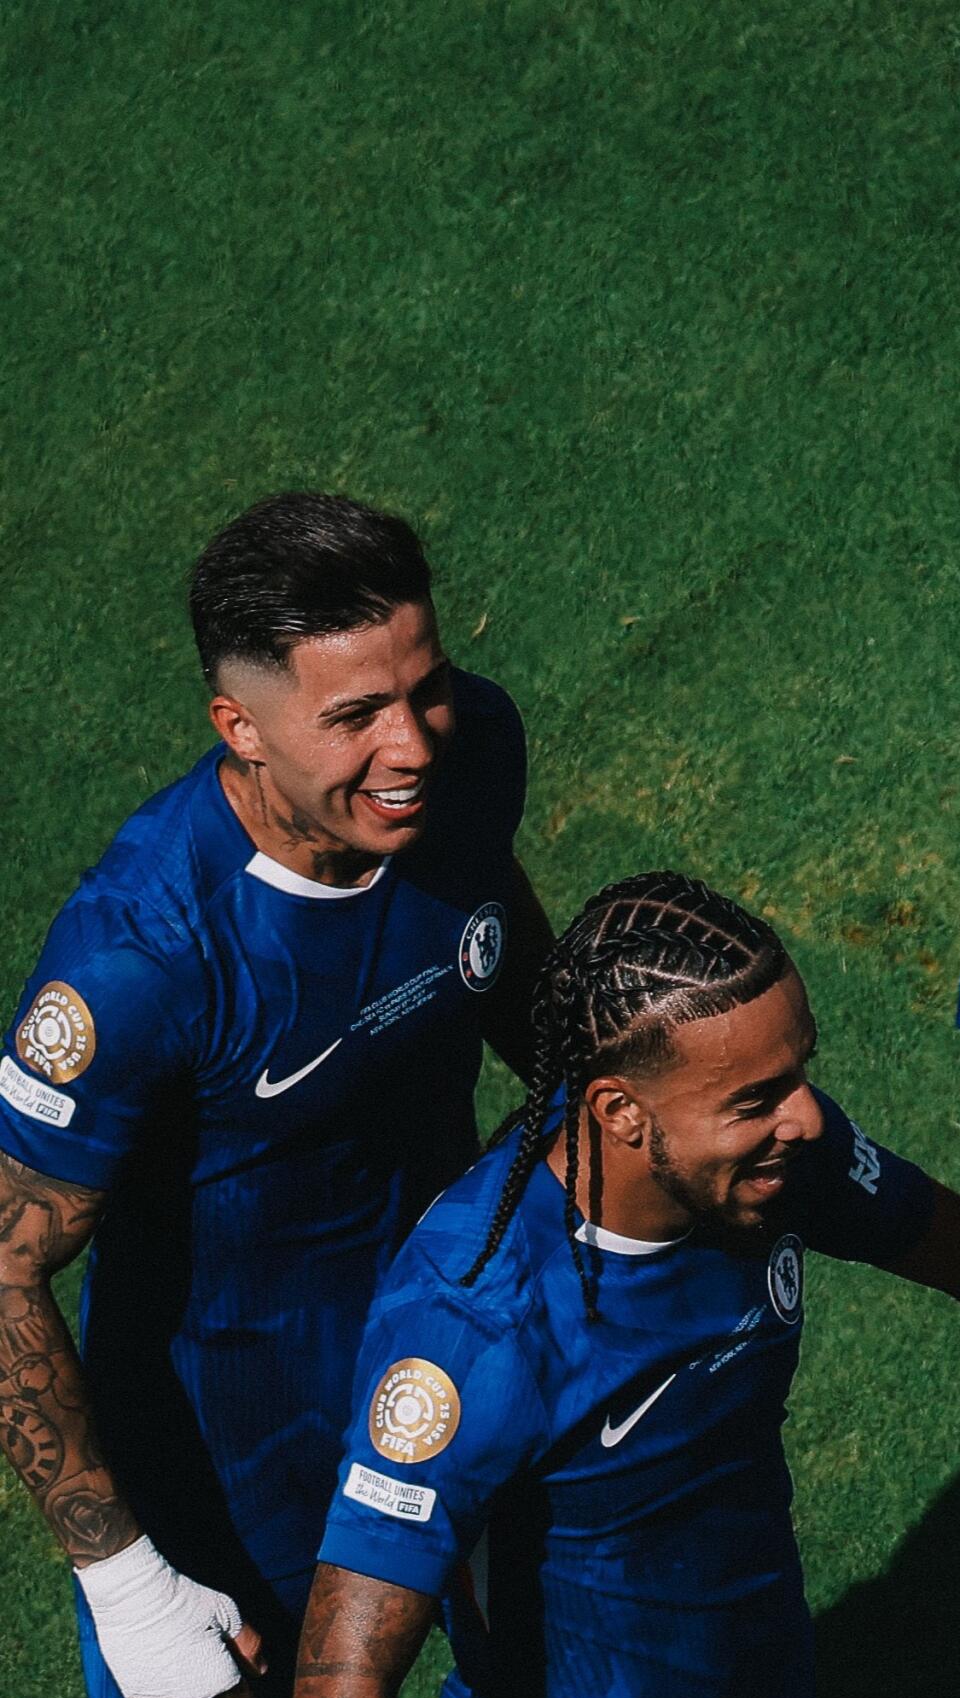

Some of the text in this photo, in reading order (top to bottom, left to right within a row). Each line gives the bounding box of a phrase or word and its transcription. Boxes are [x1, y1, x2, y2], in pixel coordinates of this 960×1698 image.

[38, 991, 69, 1007] WORLD
[68, 1005, 85, 1032] CUP
[76, 1035, 87, 1051] 25
[25, 1045, 53, 1076] FIFA
[58, 1051, 82, 1071] USA
[35, 1088, 66, 1109] UNITES
[375, 1369, 450, 1446] CLUB WORLD CUP 25 USA
[380, 1433, 416, 1457] FIFA
[360, 1469, 426, 1502] FOOTBALL UNITES
[398, 1502, 421, 1515] FIFA
